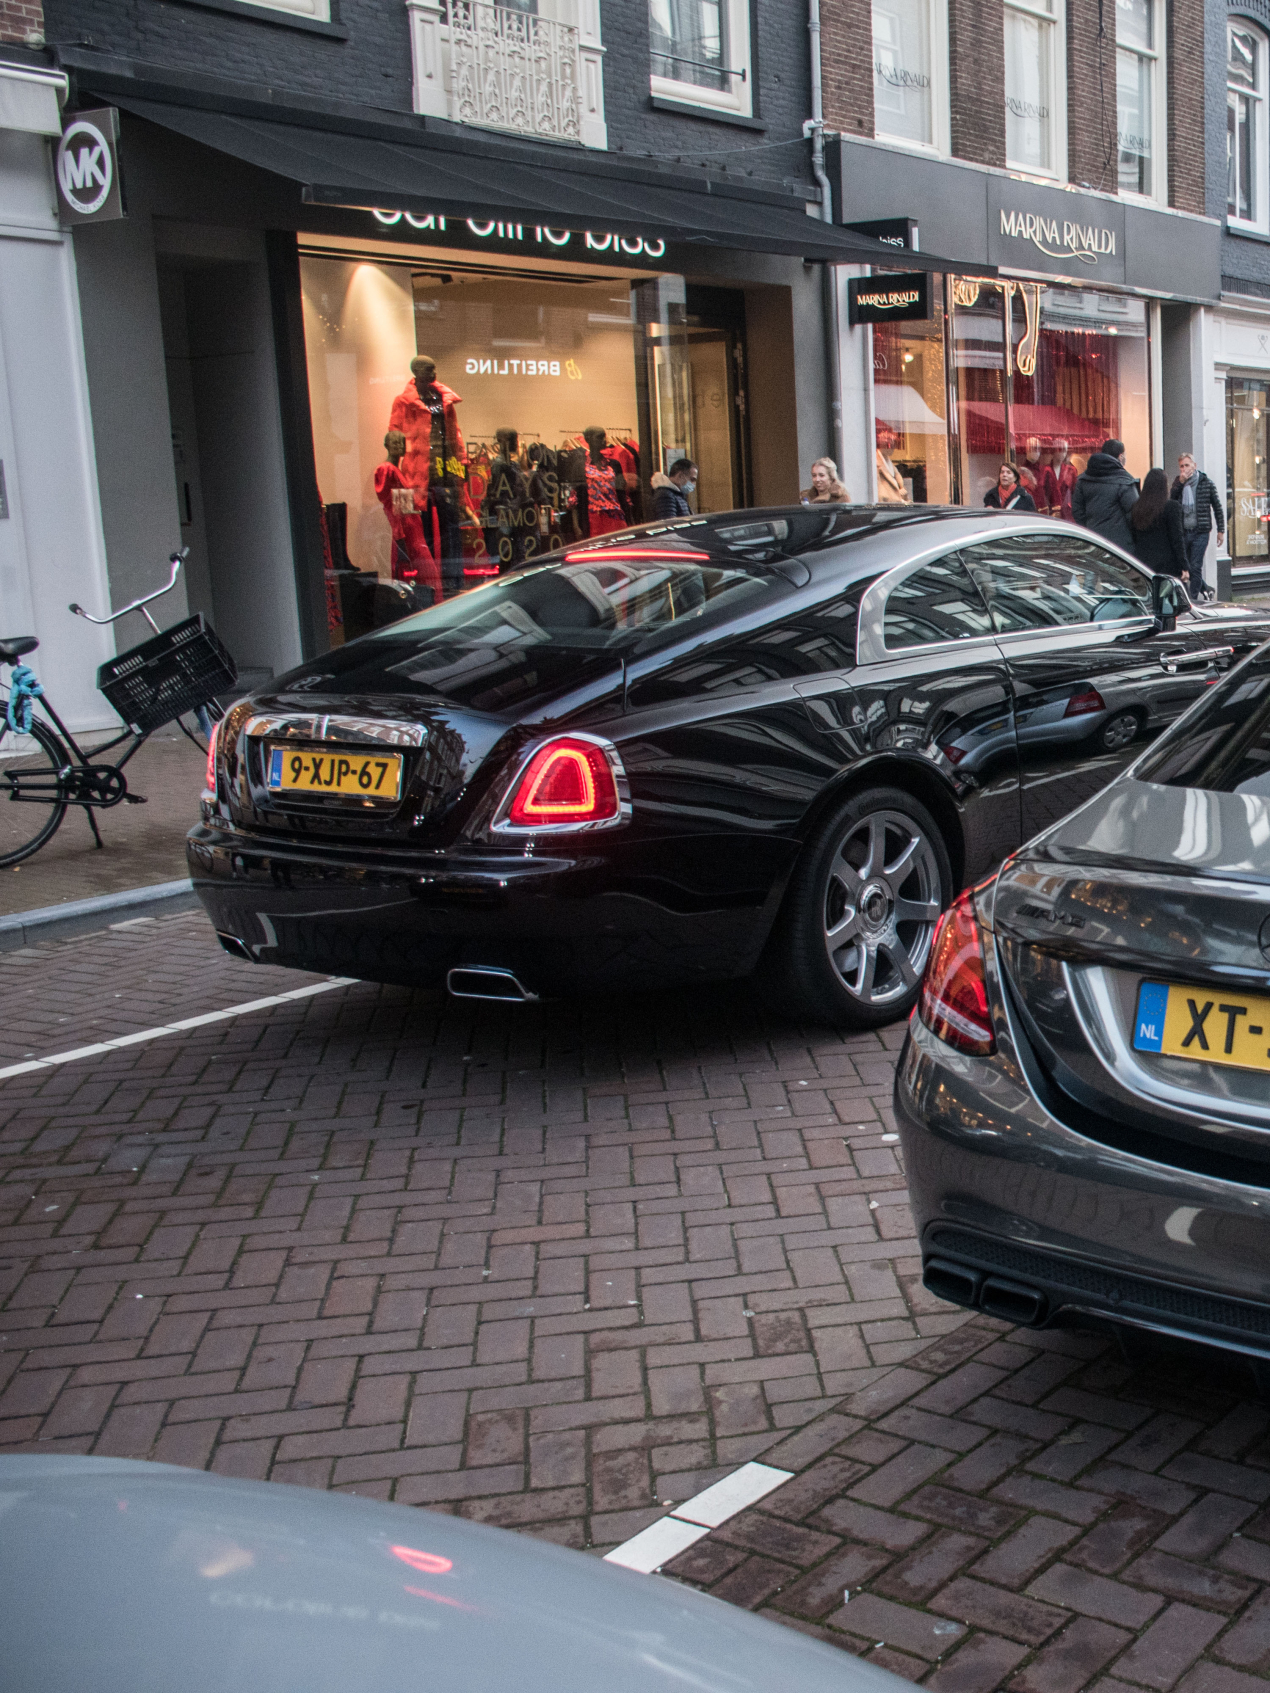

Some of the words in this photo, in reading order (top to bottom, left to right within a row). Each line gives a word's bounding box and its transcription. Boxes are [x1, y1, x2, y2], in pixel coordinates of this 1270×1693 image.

[64, 145, 106, 190] MK
[1000, 208, 1061, 257] MARINA
[1062, 220, 1117, 265] RINALDI
[857, 292, 889, 308] MARINA
[889, 290, 919, 308] RINALDI
[466, 441, 558, 467] FASHION
[468, 471, 560, 499] DAYS
[1240, 496, 1269, 517] SALE
[472, 534, 563, 565] 2020
[272, 772, 281, 781] NL
[290, 756, 389, 790] 9-XJP-67
[1139, 1023, 1159, 1041] NL
